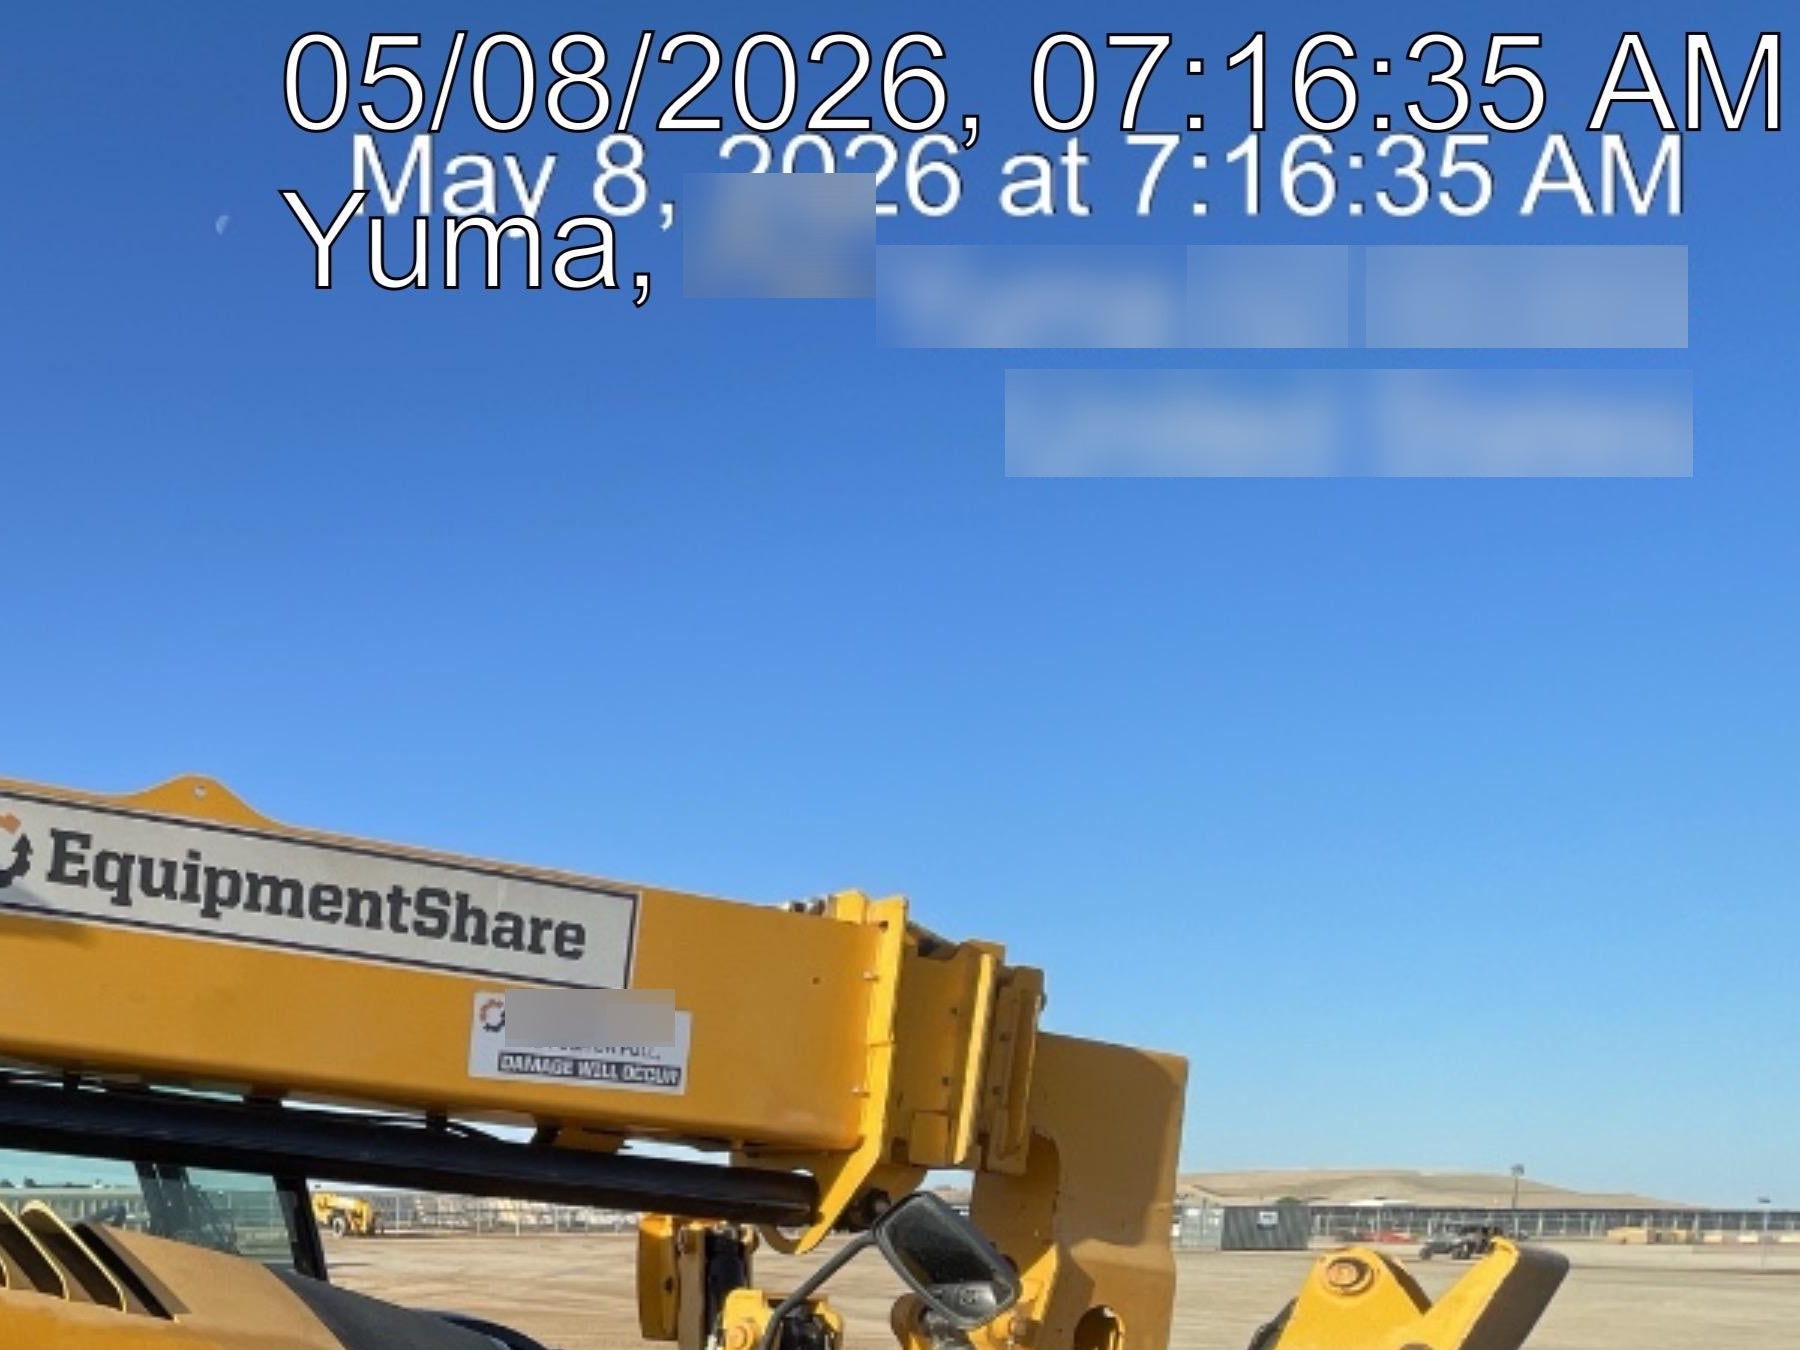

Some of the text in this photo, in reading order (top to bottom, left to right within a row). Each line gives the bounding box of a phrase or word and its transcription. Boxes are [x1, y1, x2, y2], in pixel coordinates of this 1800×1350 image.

[46, 828, 587, 962] EquipmentShare
[501, 1054, 574, 1076] DAMAGE
[578, 1060, 618, 1080] WILL
